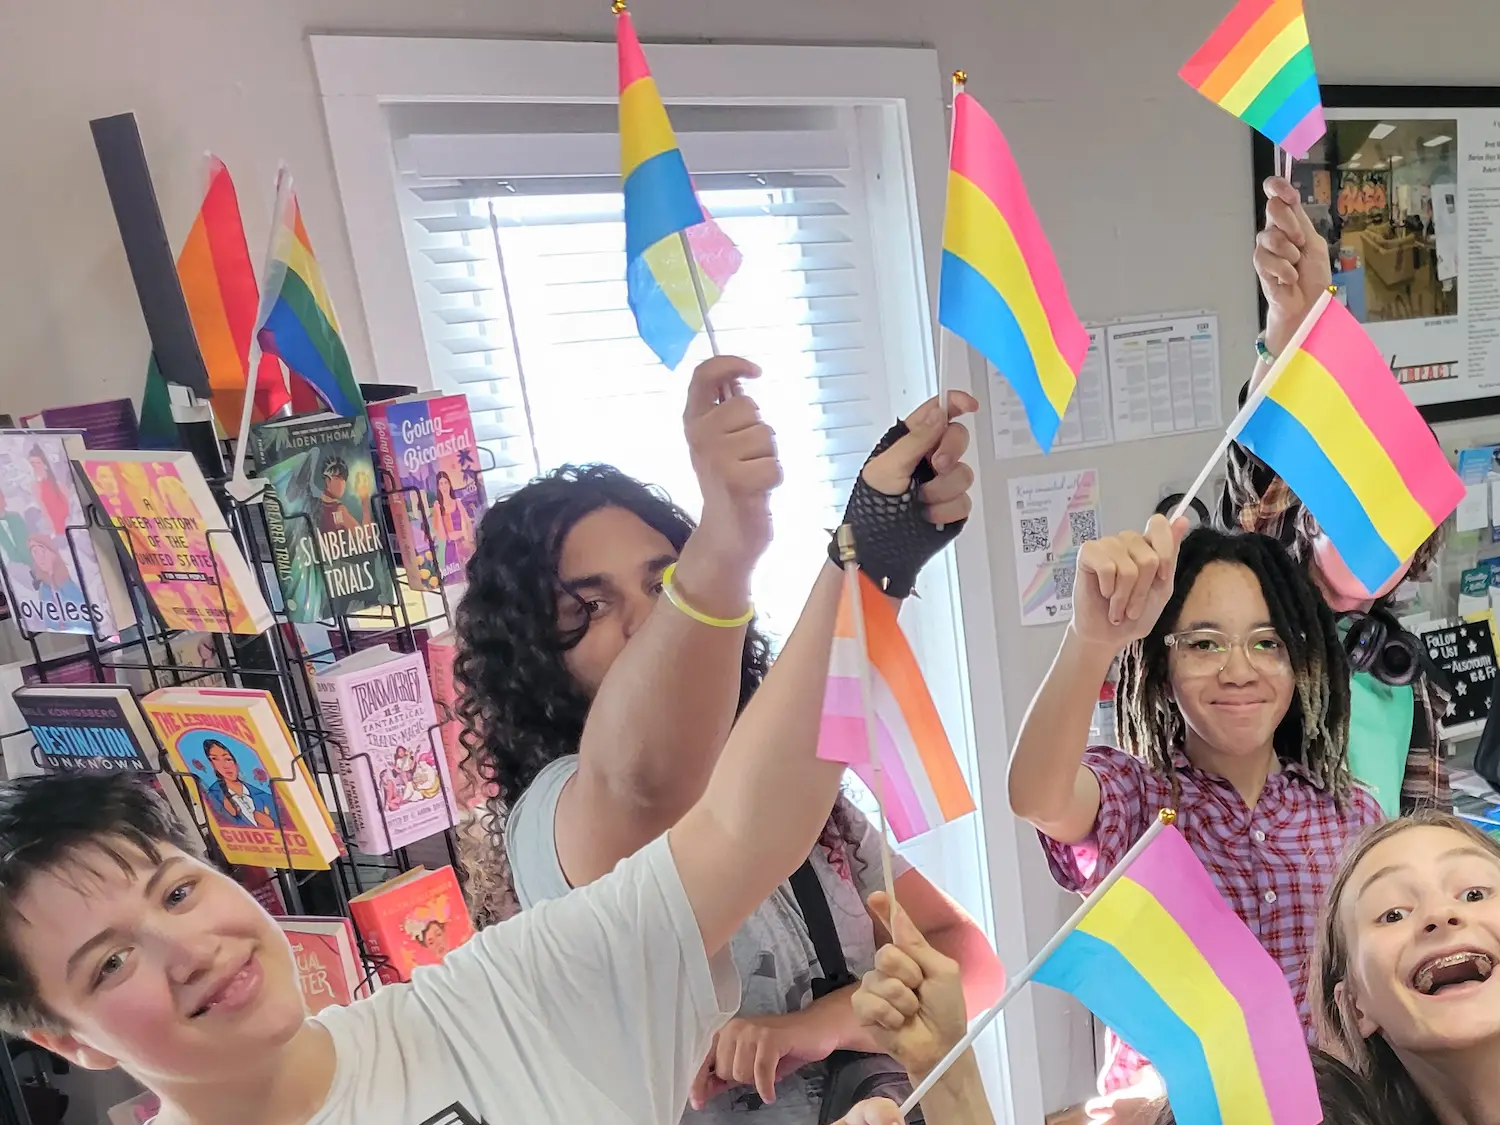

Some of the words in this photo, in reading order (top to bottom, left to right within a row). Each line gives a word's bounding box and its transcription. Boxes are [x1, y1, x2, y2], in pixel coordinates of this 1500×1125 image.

[401, 416, 454, 445] Going
[403, 427, 473, 473] Bicoastal
[142, 498, 154, 511] A
[117, 516, 153, 530] QUEER
[154, 516, 199, 530] HISTORY
[147, 535, 161, 548] OF
[167, 535, 188, 548] THE
[137, 553, 175, 567] UNITED
[324, 561, 375, 599] TRIALS
[20, 592, 104, 622] oveless
[316, 682, 336, 693] DAVIS
[151, 711, 181, 739] THE
[362, 707, 425, 733] FANTASTICAL
[31, 725, 138, 758] DESTINATION
[366, 732, 398, 748] TRANS
[400, 719, 426, 744] MAGIC
[47, 755, 145, 771] UNKNOWN
[220, 829, 281, 845] GUIDE
